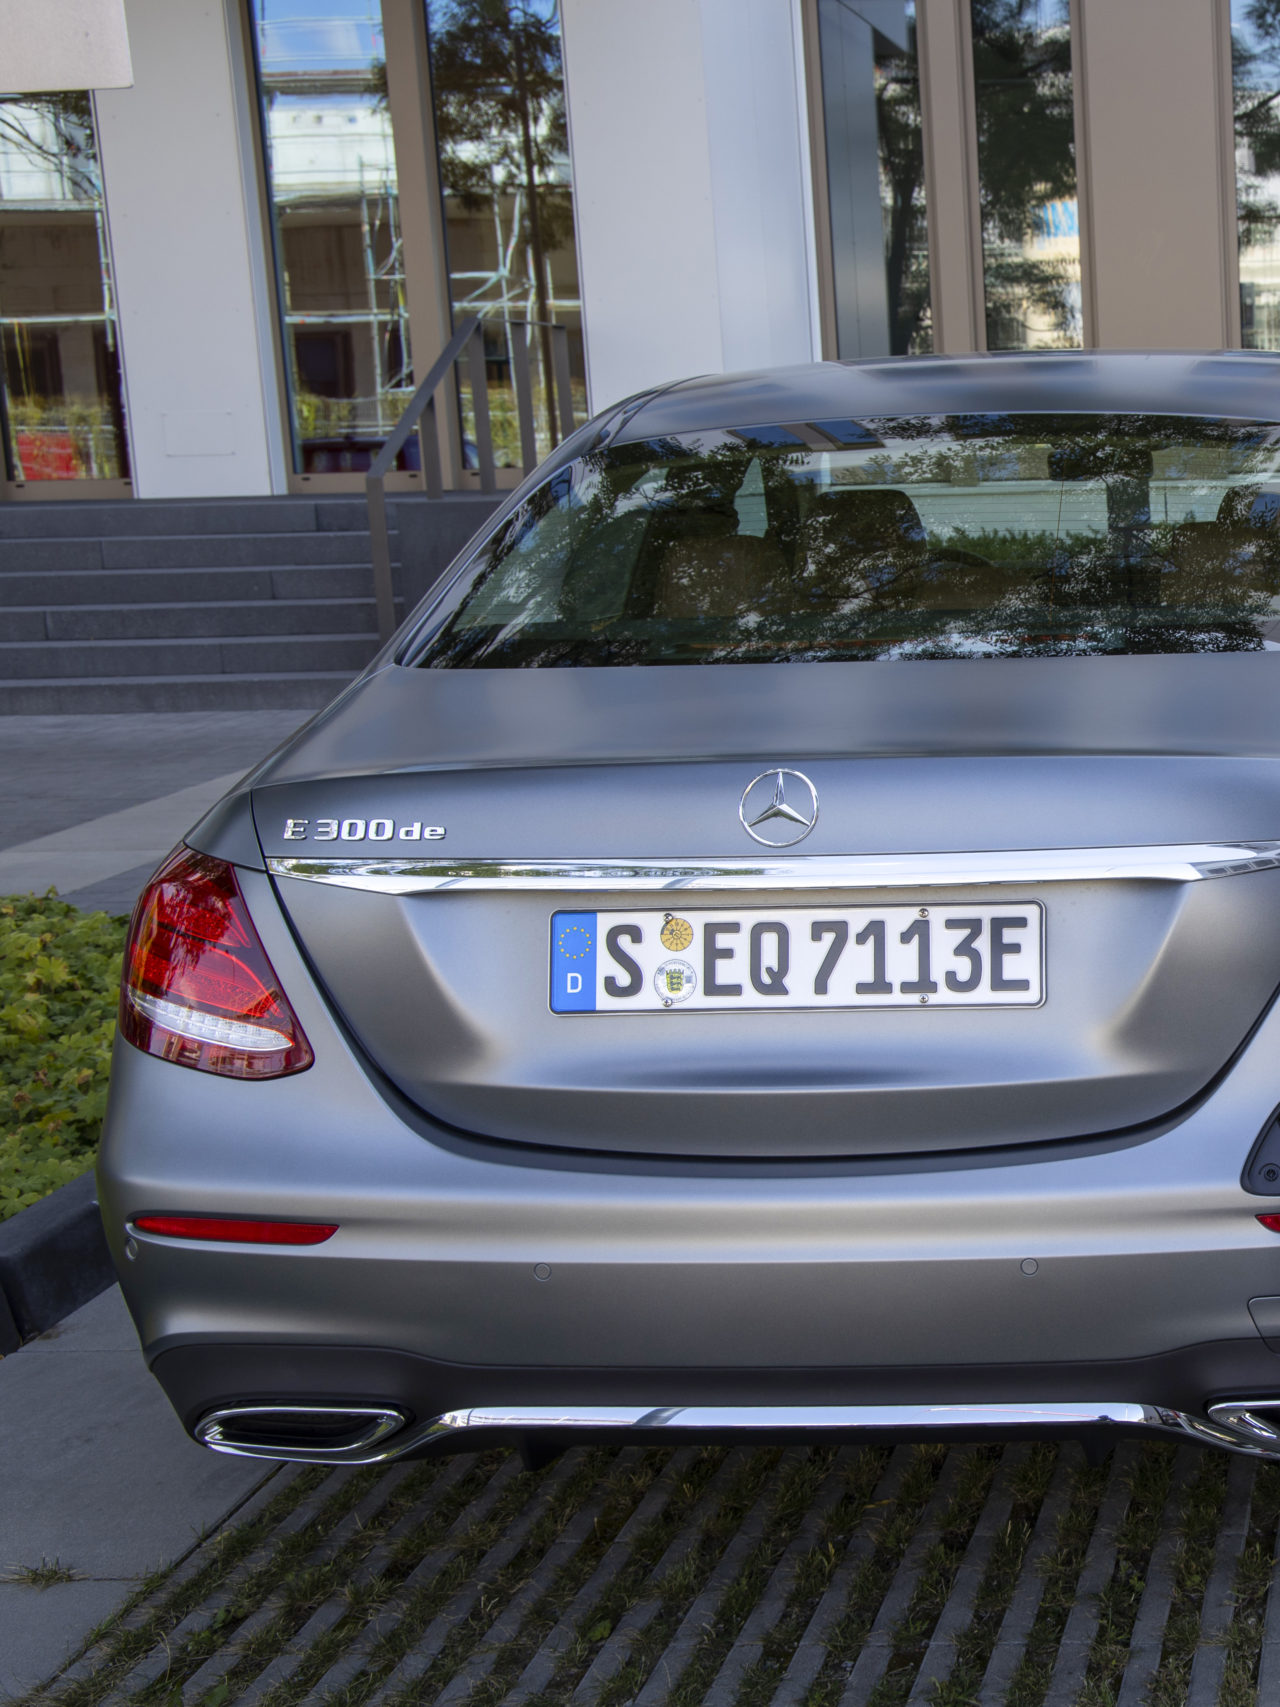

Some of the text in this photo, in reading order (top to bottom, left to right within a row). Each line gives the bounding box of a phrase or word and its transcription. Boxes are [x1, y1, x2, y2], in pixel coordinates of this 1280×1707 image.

[604, 924, 643, 997] S
[703, 922, 789, 996] EQ
[810, 916, 1030, 995] 7113E
[567, 973, 582, 993] D
